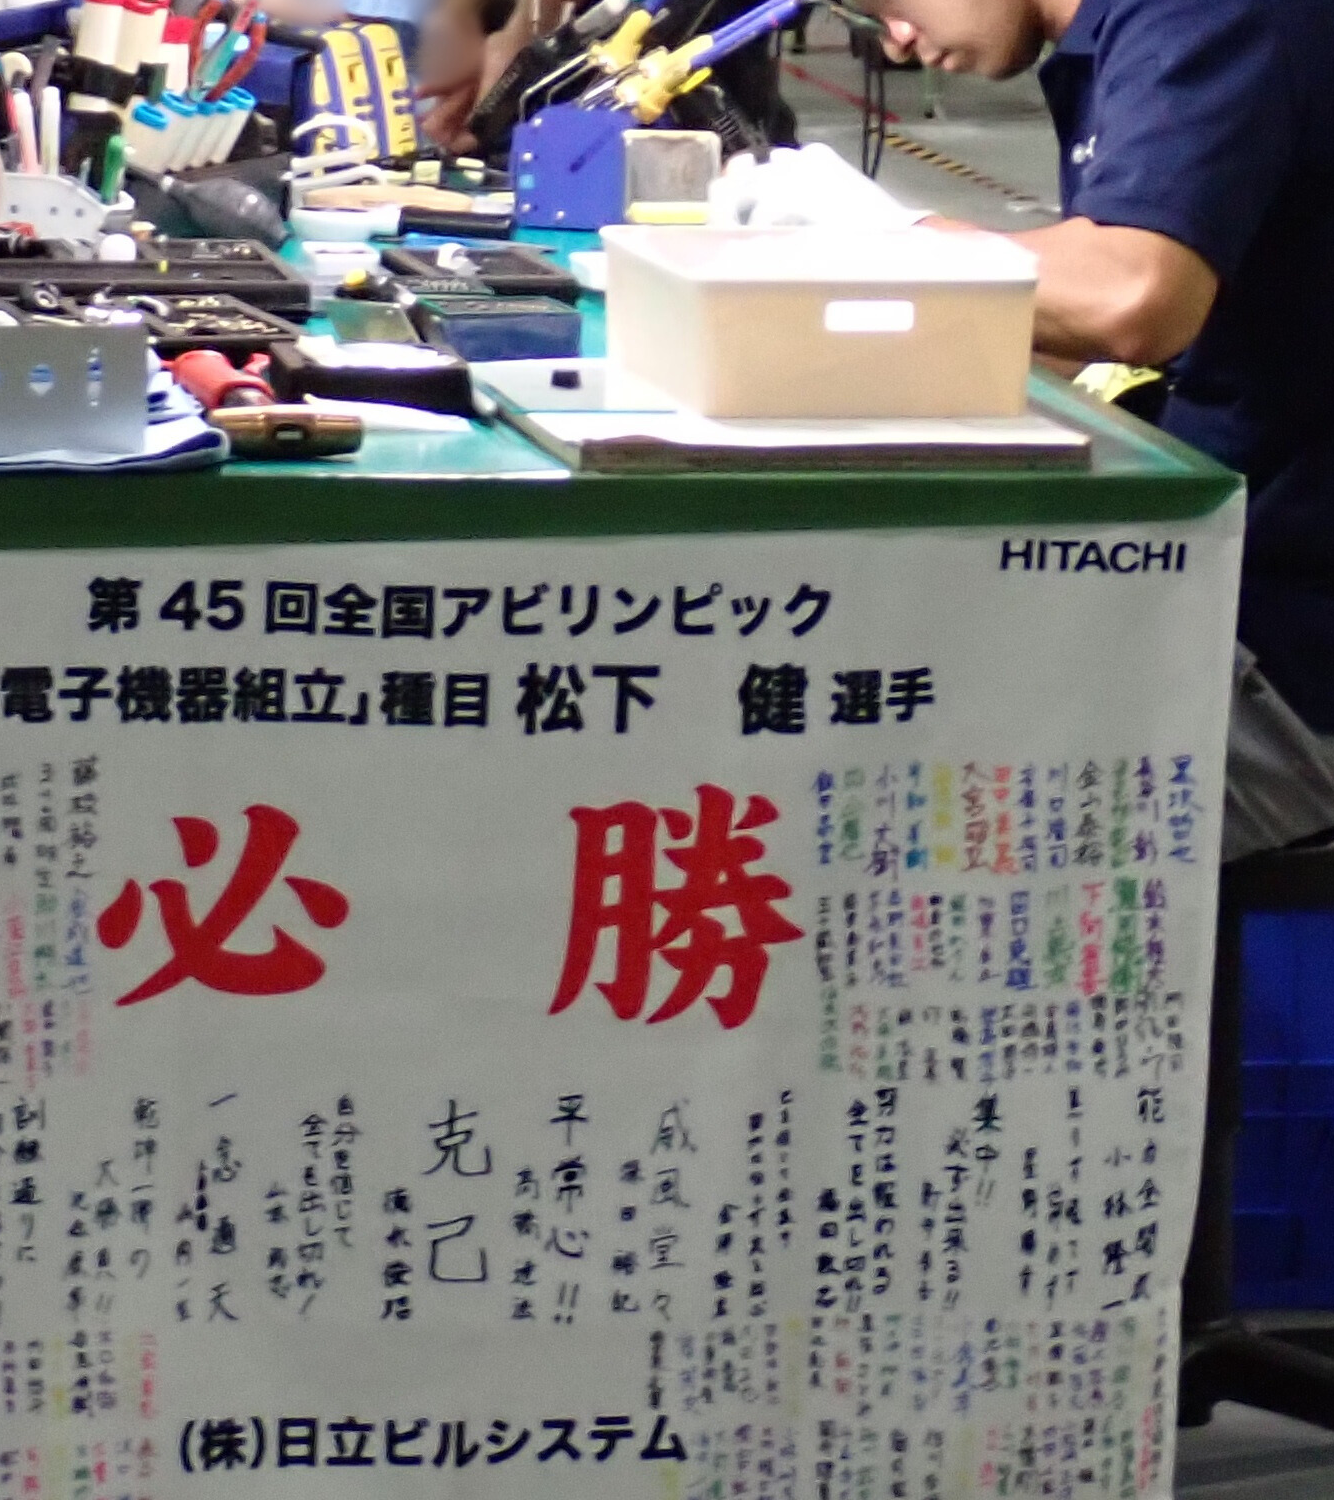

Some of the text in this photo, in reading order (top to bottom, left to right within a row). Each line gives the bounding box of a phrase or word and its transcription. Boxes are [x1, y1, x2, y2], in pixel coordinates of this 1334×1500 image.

[998, 538, 1188, 574] HITACHI
[515, 661, 661, 735] 松下
[737, 662, 809, 735] 健
[829, 666, 936, 724] 選手
[97, 802, 351, 1006] 必
[546, 782, 805, 1031] 勝
[421, 1099, 495, 1284] 克己
[177, 1413, 690, 1473] (株)日立ビルシステム
